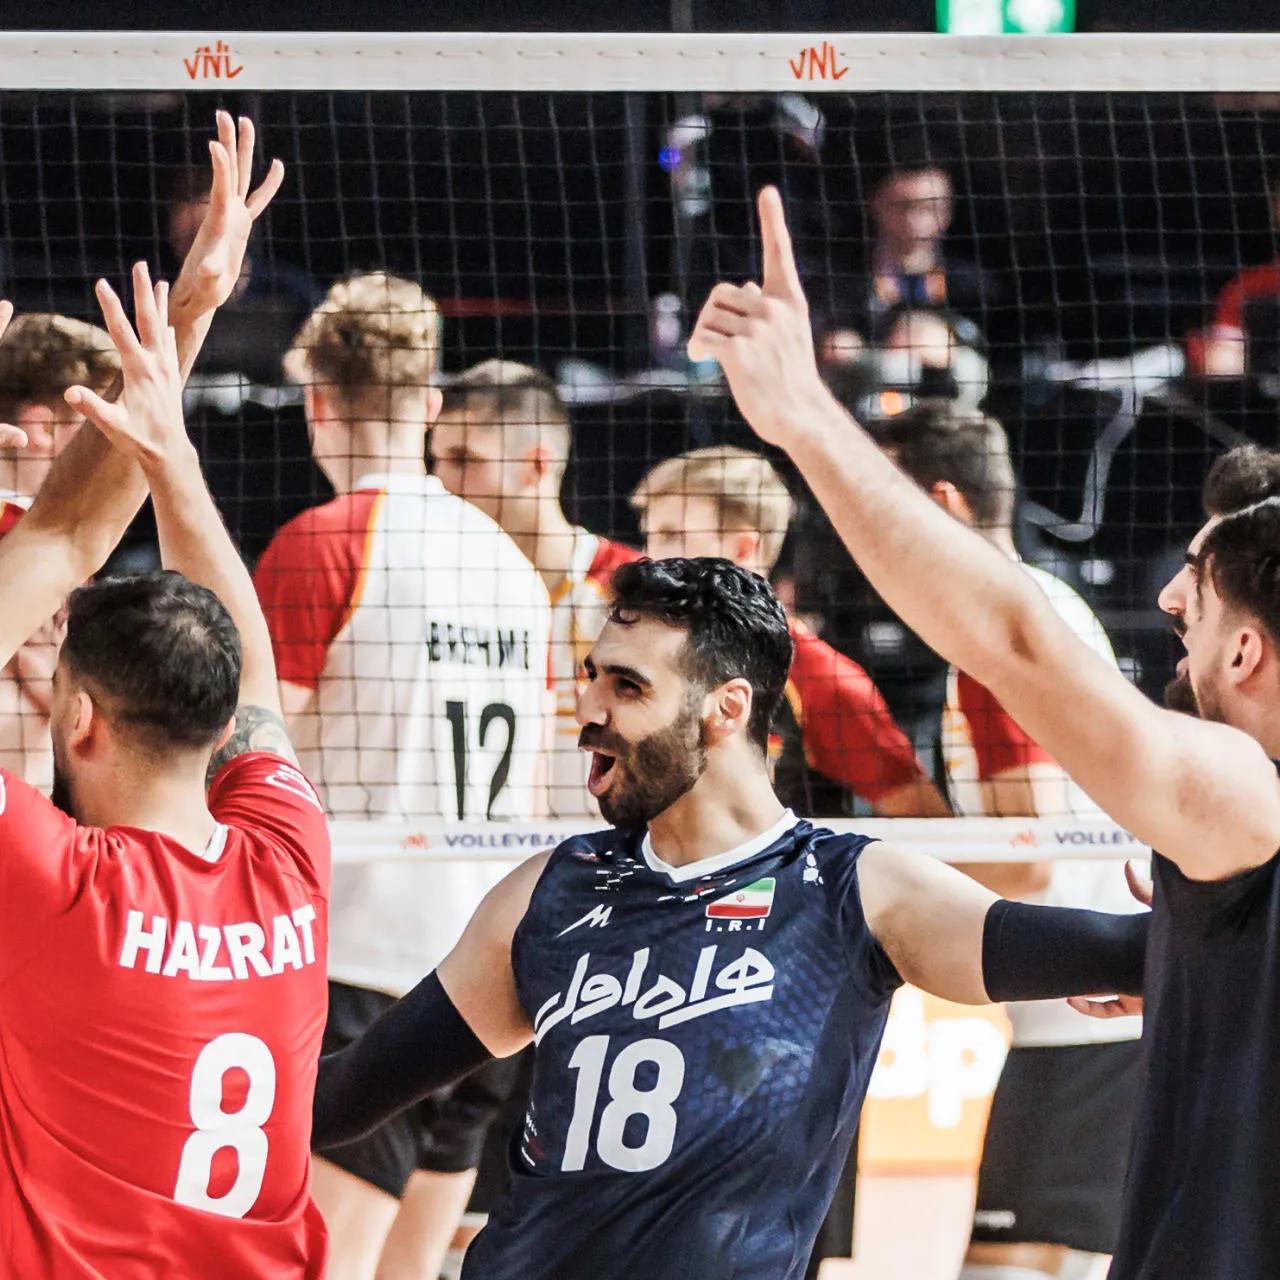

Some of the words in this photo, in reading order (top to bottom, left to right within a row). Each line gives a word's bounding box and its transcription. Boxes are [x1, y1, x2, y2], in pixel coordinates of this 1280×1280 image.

[445, 700, 517, 821] 12
[444, 833, 566, 848] VOLLEYBA
[118, 903, 318, 982] HAZRAT
[173, 1031, 277, 1220] 8
[560, 1034, 687, 1174] 18
